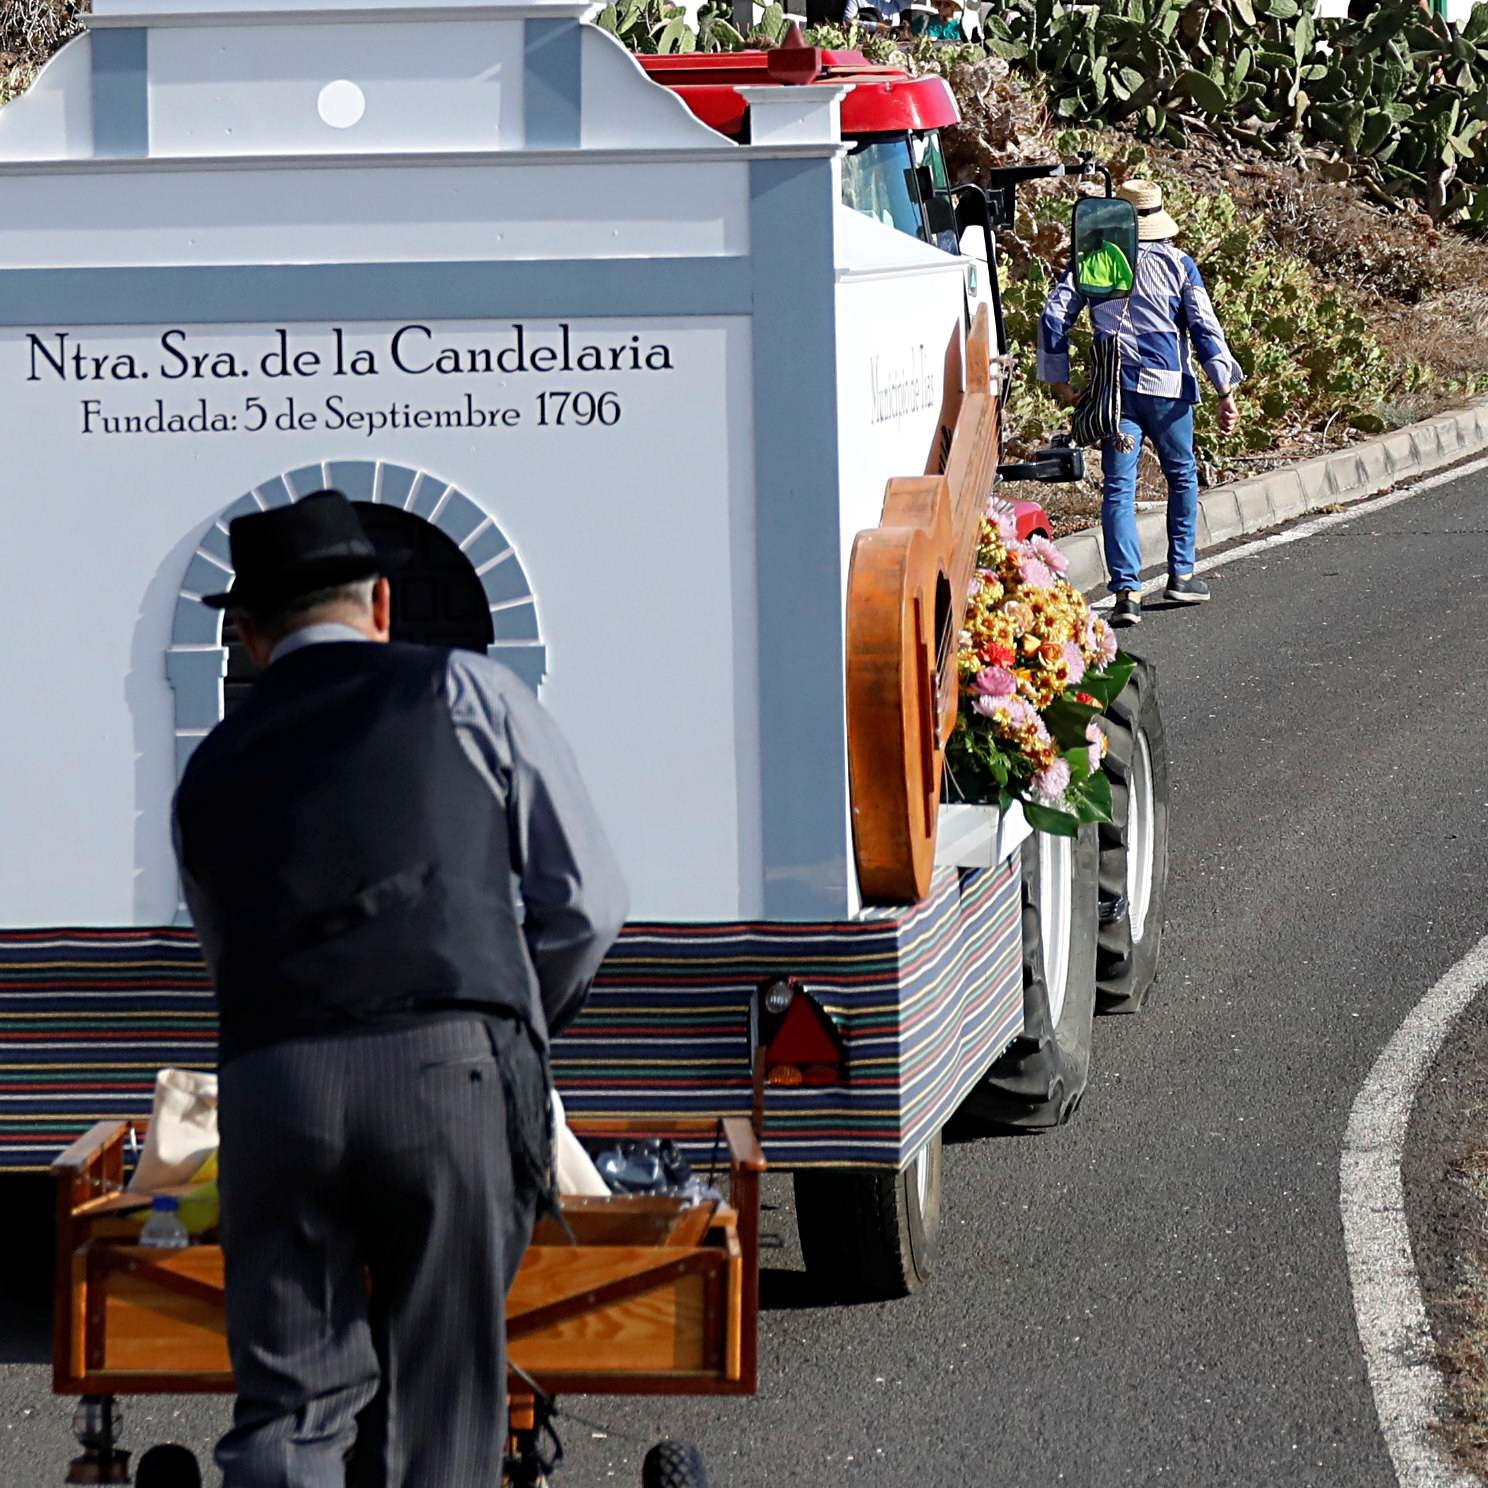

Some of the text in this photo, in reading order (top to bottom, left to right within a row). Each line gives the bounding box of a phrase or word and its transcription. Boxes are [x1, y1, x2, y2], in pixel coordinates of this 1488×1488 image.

[25, 323, 675, 381] Ntra. Sra. de la Candelaria
[80, 391, 622, 437] Fundada: 5 de Septiembre 1796
